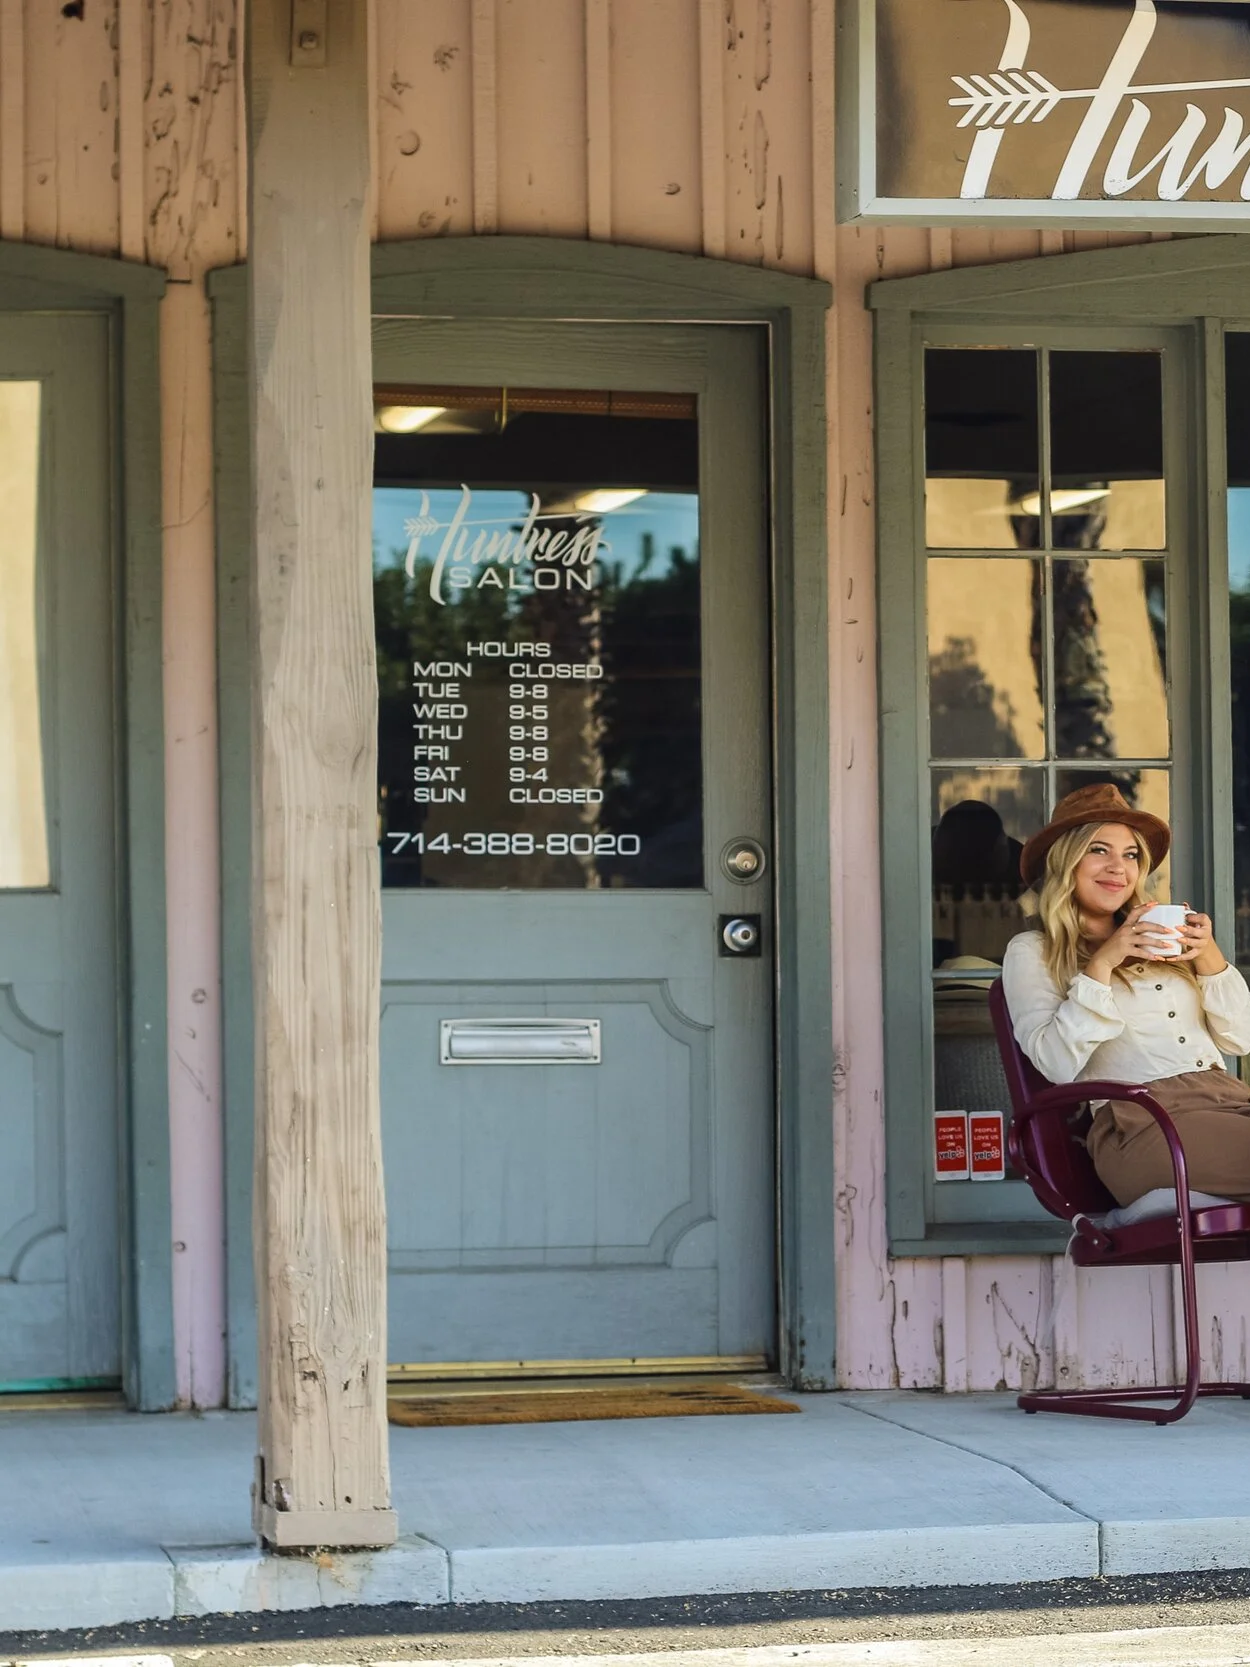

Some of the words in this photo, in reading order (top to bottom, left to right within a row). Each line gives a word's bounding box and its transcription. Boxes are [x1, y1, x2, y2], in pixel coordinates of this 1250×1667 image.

[403, 483, 612, 606] Huntress
[449, 566, 592, 590] SALON
[466, 641, 551, 657] HOURS
[413, 662, 472, 678] MON
[509, 663, 604, 679] CLOSED
[412, 682, 460, 698] TUE
[509, 684, 549, 699] 9-8
[412, 703, 468, 719] WED
[509, 705, 549, 720] 9-5
[412, 724, 463, 740] THU
[509, 725, 549, 741] 9-8
[413, 745, 449, 761] FRI
[509, 746, 549, 762] 9-8
[413, 766, 461, 782] SAT
[509, 767, 549, 783] 9-4
[413, 787, 466, 803] SUN
[509, 788, 604, 804] CLOSED
[386, 832, 641, 855] 714-388-8020
[938, 1150, 957, 1160] yelp
[974, 1150, 993, 1160] yelp
